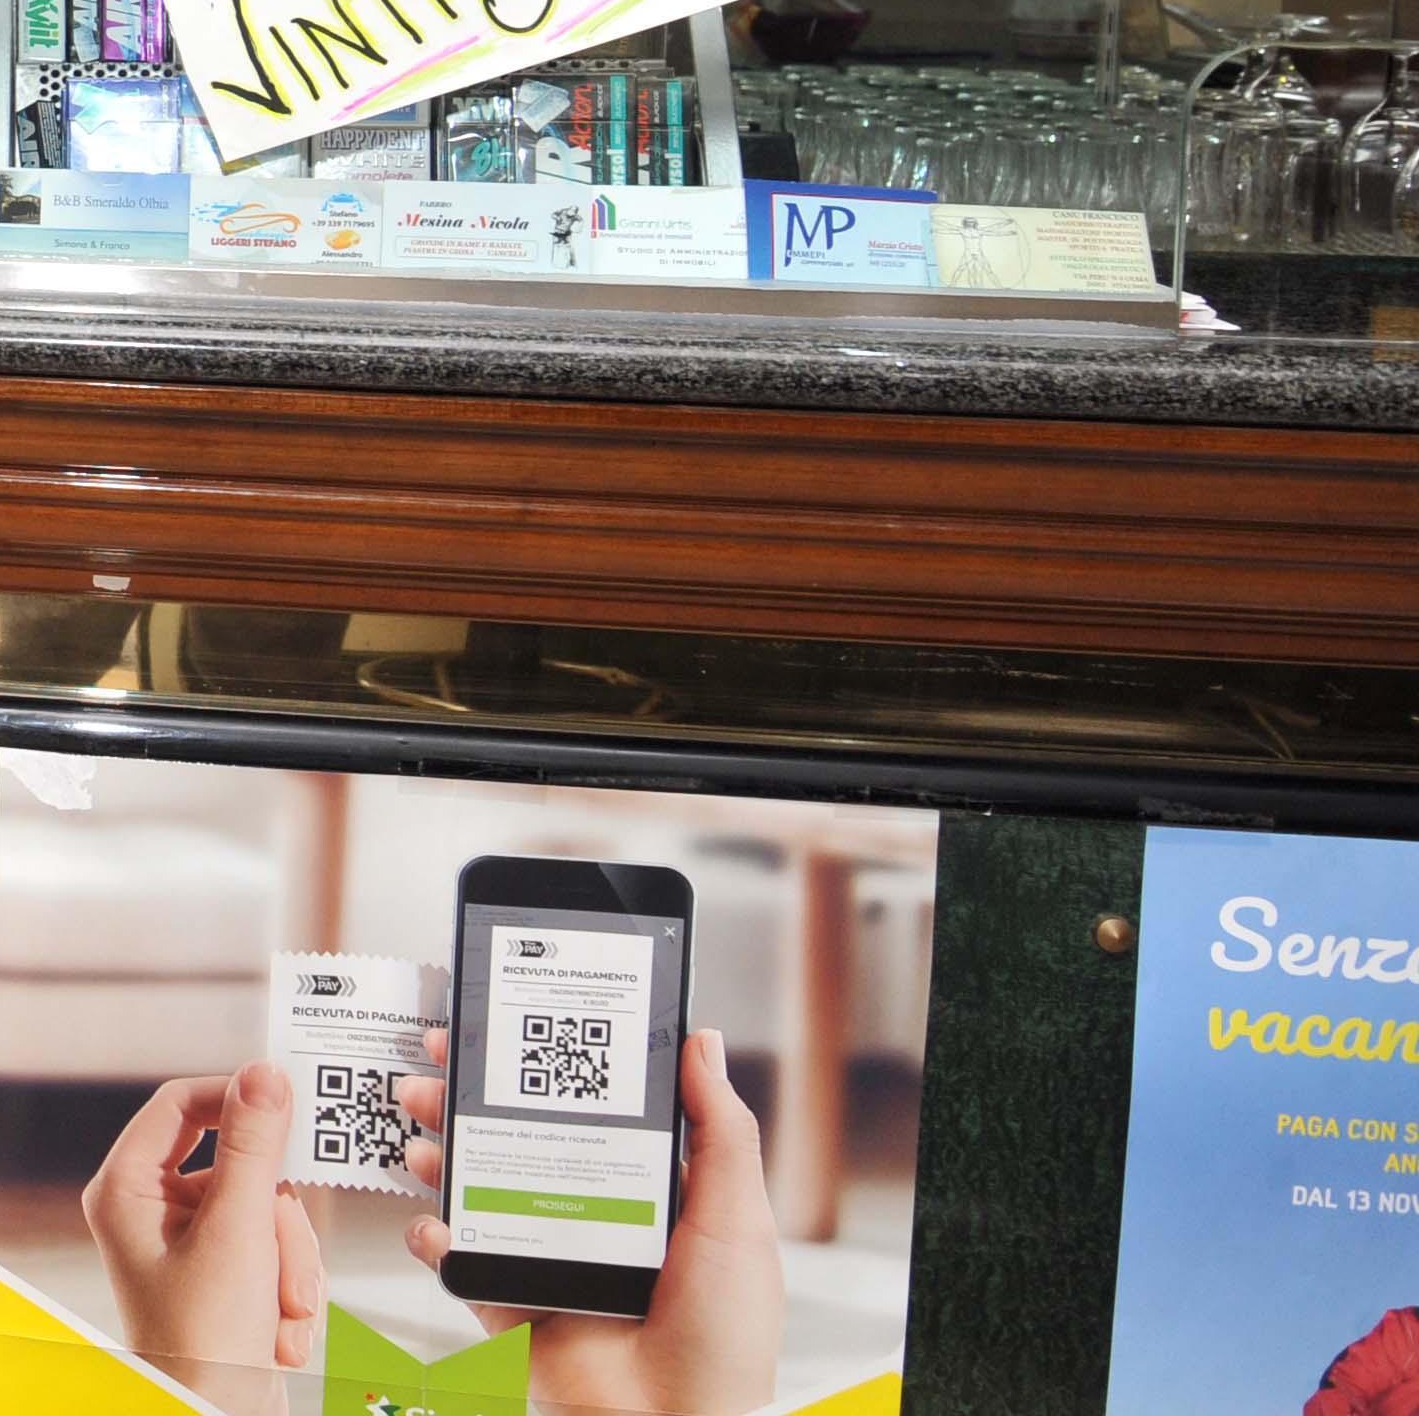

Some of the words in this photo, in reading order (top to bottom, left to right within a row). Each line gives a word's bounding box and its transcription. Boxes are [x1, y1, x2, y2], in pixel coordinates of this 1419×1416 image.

[321, 129, 427, 151] HAPPYDENT
[53, 194, 81, 208] B&B
[85, 195, 136, 209] Smeraldo
[139, 196, 170, 210] Olbia
[329, 209, 359, 219] Stefano
[397, 213, 464, 229] Mesina
[470, 215, 530, 231] Nicola
[211, 237, 251, 248] LIGGERI
[253, 238, 298, 249] STEFANO
[784, 202, 857, 268] MP
[54, 239, 88, 250] Simona
[90, 240, 97, 250] &
[524, 944, 544, 955] PAY
[502, 964, 556, 978] RICEVUTA
[557, 968, 570, 978] DI
[570, 969, 639, 983] PAGAMENTO
[316, 979, 340, 992] PAY
[292, 1005, 355, 1020] RICEVUTA
[356, 1010, 370, 1021] DI
[467, 1124, 515, 1139] Scansione
[516, 1129, 533, 1141] del
[534, 1131, 567, 1143] codice
[568, 1135, 608, 1146] ricevuta
[1276, 1113, 1340, 1140] PAGA
[1347, 1117, 1397, 1142] CON
[532, 1198, 585, 1213] PROSEGUI
[1292, 1185, 1338, 1210] DAL
[1346, 1190, 1371, 1213] 13
